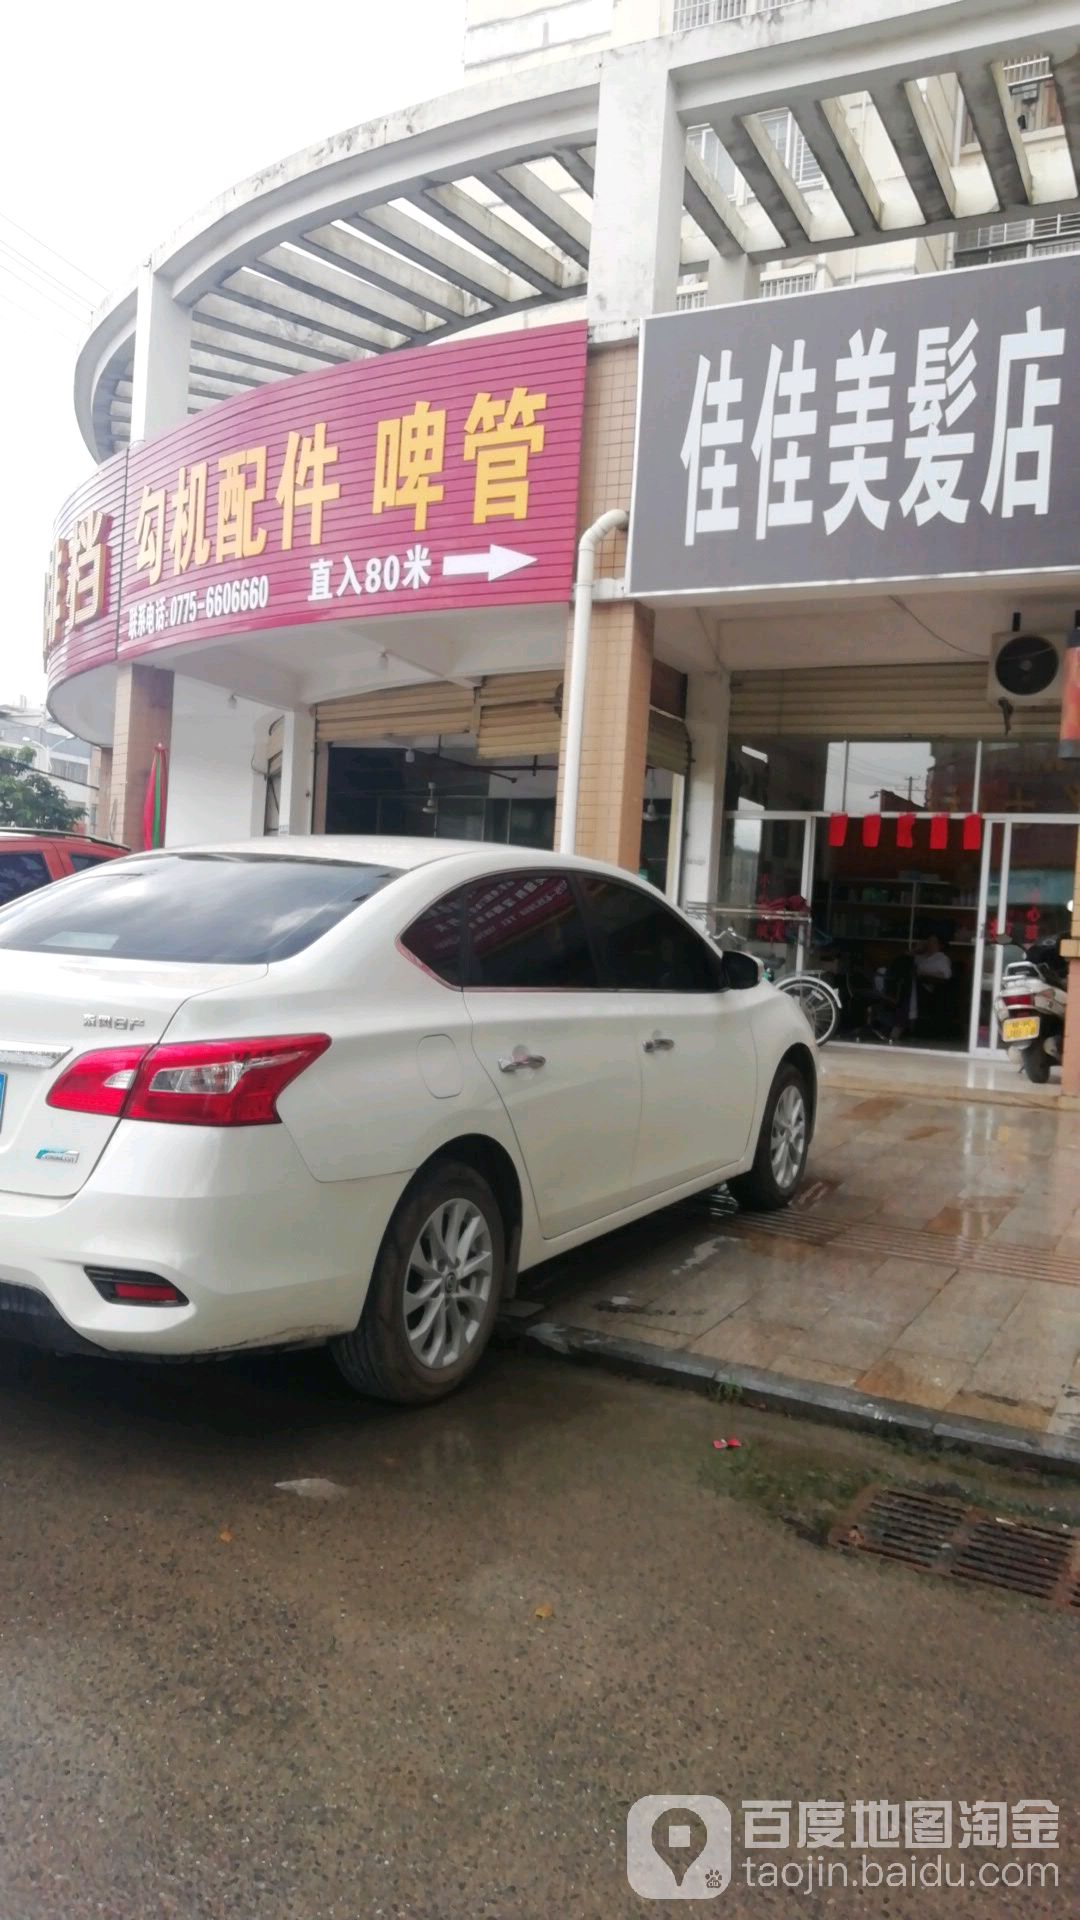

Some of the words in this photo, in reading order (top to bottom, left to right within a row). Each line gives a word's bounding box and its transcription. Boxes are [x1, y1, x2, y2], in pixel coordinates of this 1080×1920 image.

[135, 422, 340, 586] 勾机配件
[372, 387, 548, 532] 啤管
[307, 545, 432, 603] 直入80米
